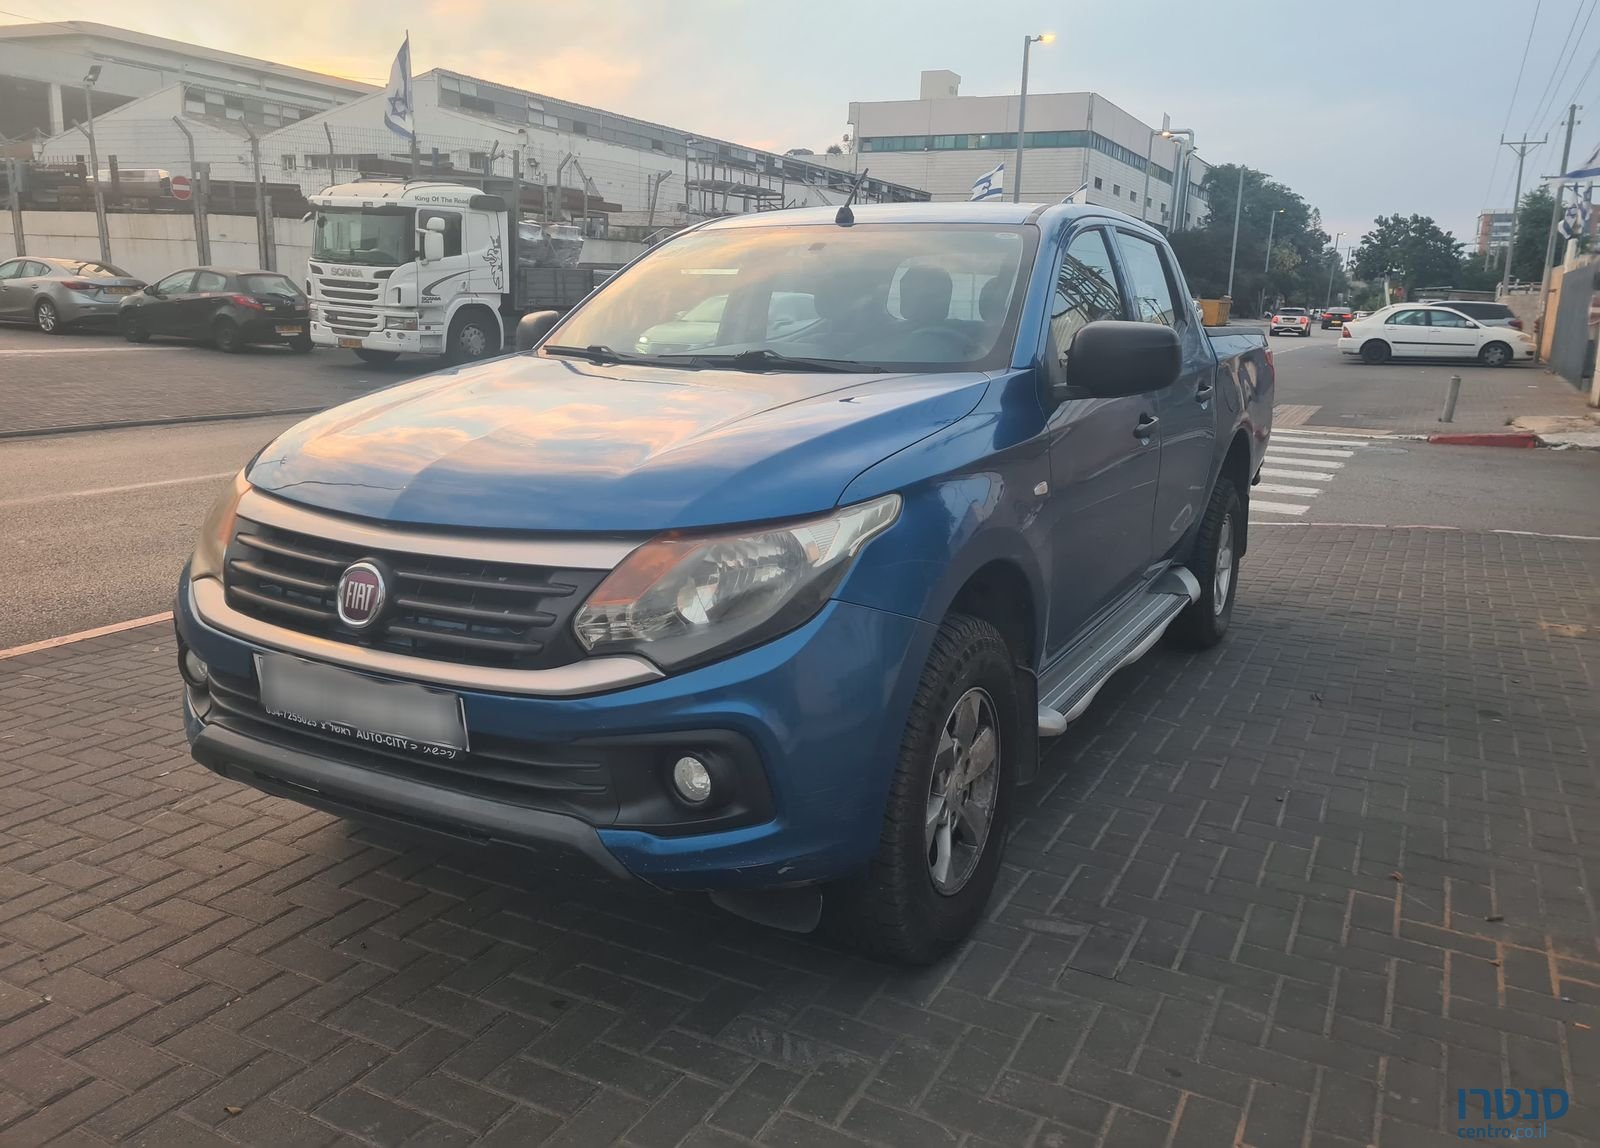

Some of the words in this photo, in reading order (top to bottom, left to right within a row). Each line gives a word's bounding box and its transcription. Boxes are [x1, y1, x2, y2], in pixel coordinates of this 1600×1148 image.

[414, 195, 430, 203] King
[330, 266, 364, 278] SCANIA
[345, 580, 375, 611] FIAT
[356, 729, 408, 749] AUTO-CITY
